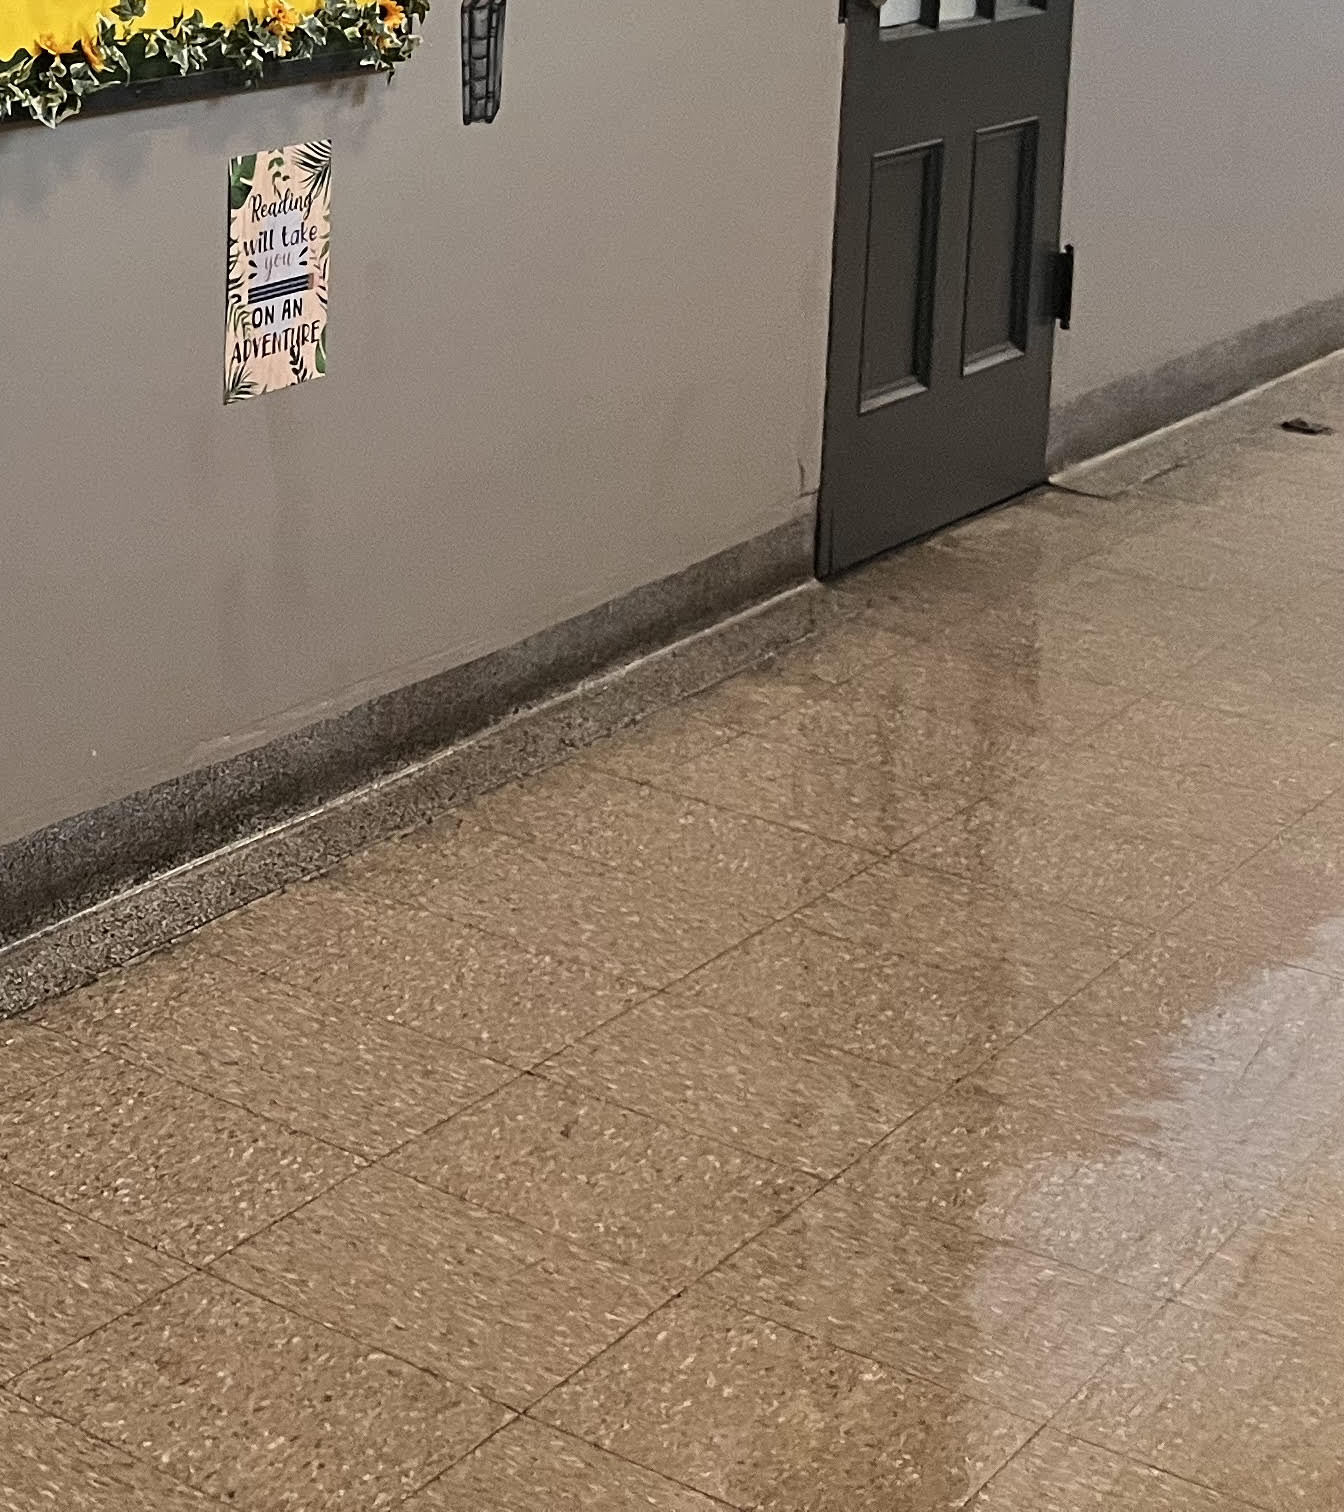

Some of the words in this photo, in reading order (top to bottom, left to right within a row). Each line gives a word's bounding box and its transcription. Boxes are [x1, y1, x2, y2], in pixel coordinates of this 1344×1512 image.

[247, 188, 314, 223] Reading
[243, 230, 274, 257] will
[281, 224, 318, 248] take
[264, 252, 294, 281] you
[251, 304, 275, 329] ON
[281, 297, 303, 323] AN
[231, 319, 321, 364] ADVENTURE
